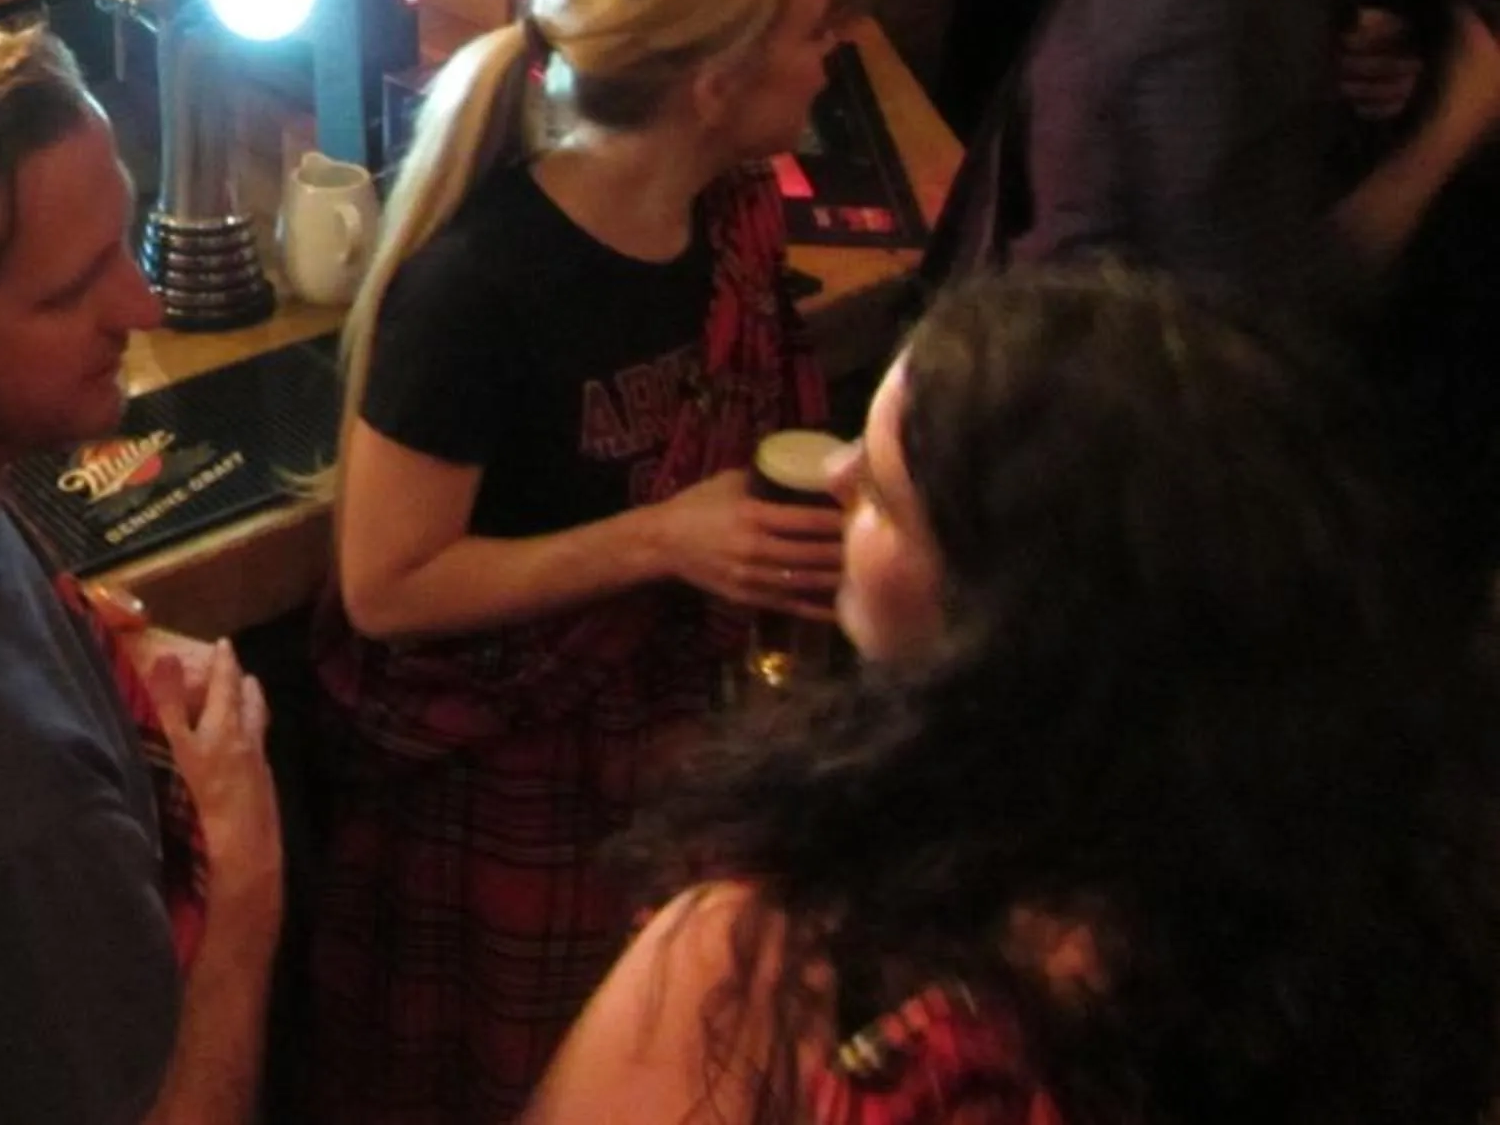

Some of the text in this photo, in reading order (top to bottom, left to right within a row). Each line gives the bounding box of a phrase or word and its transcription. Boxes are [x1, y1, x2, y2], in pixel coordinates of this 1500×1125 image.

[57, 429, 177, 504] Miller
[103, 450, 245, 545] GENUINE DRAFT
